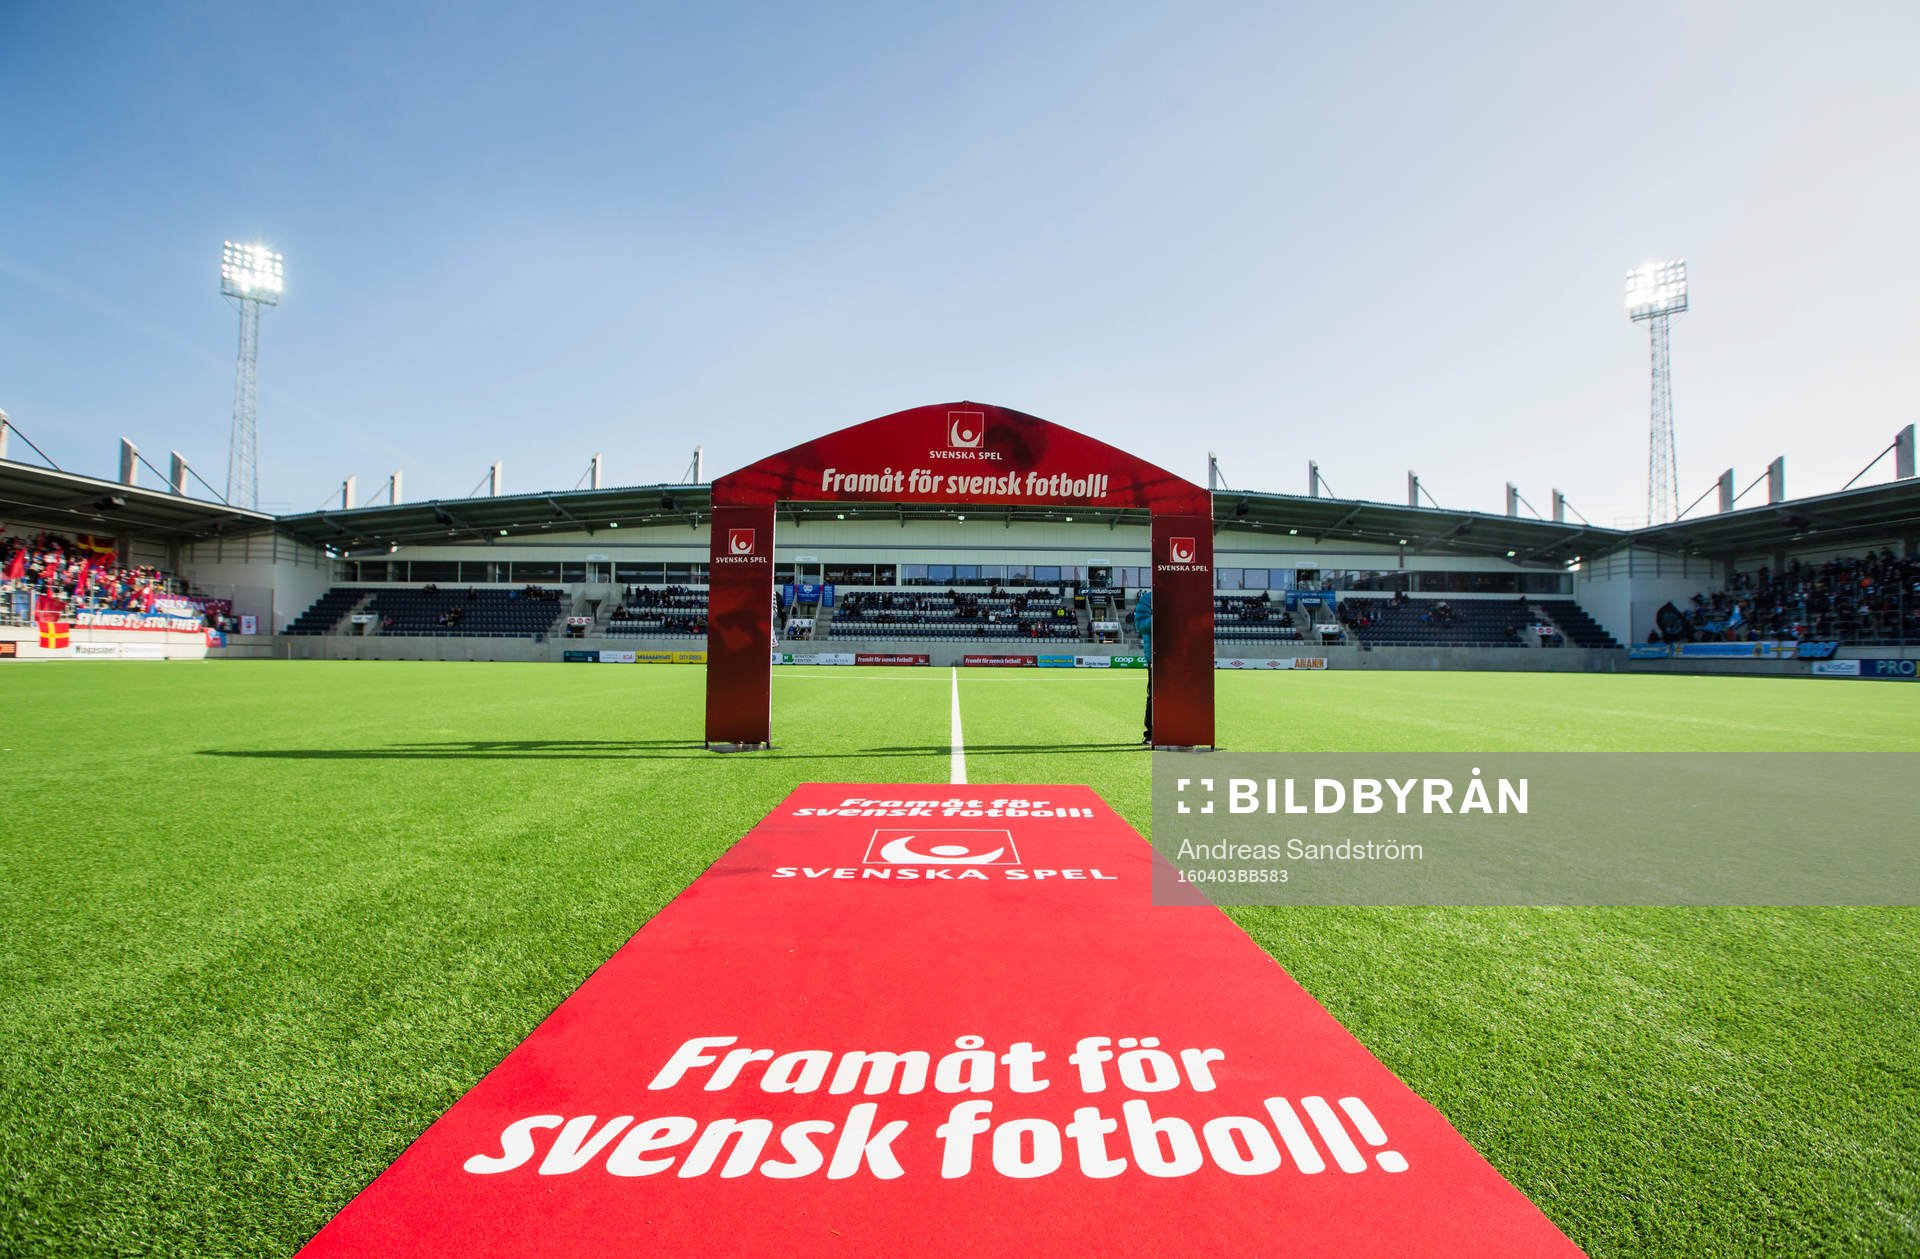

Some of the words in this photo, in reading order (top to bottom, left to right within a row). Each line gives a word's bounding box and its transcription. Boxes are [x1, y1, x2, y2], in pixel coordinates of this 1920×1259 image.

[929, 450, 976, 460] SVENSKA
[978, 451, 1003, 461] SPEL
[821, 467, 904, 493] Framåt
[908, 470, 943, 494] för
[946, 473, 1022, 496] svensk
[1025, 472, 1108, 498] fotboll!
[715, 556, 748, 564] SVENSKA
[1157, 564, 1190, 572] SVENSKA
[1114, 656, 1134, 664] coop
[839, 797, 984, 809] Framåt
[990, 798, 1051, 810] för
[792, 807, 933, 817] svensk
[940, 807, 1095, 818] fotboll!
[771, 866, 990, 880] SVENSKA
[1006, 868, 1118, 880] SPEL
[647, 1035, 1050, 1095] Framåt
[1068, 1036, 1225, 1094] för
[463, 1102, 909, 1180] svensk
[935, 1095, 1409, 1180] fotboll!
